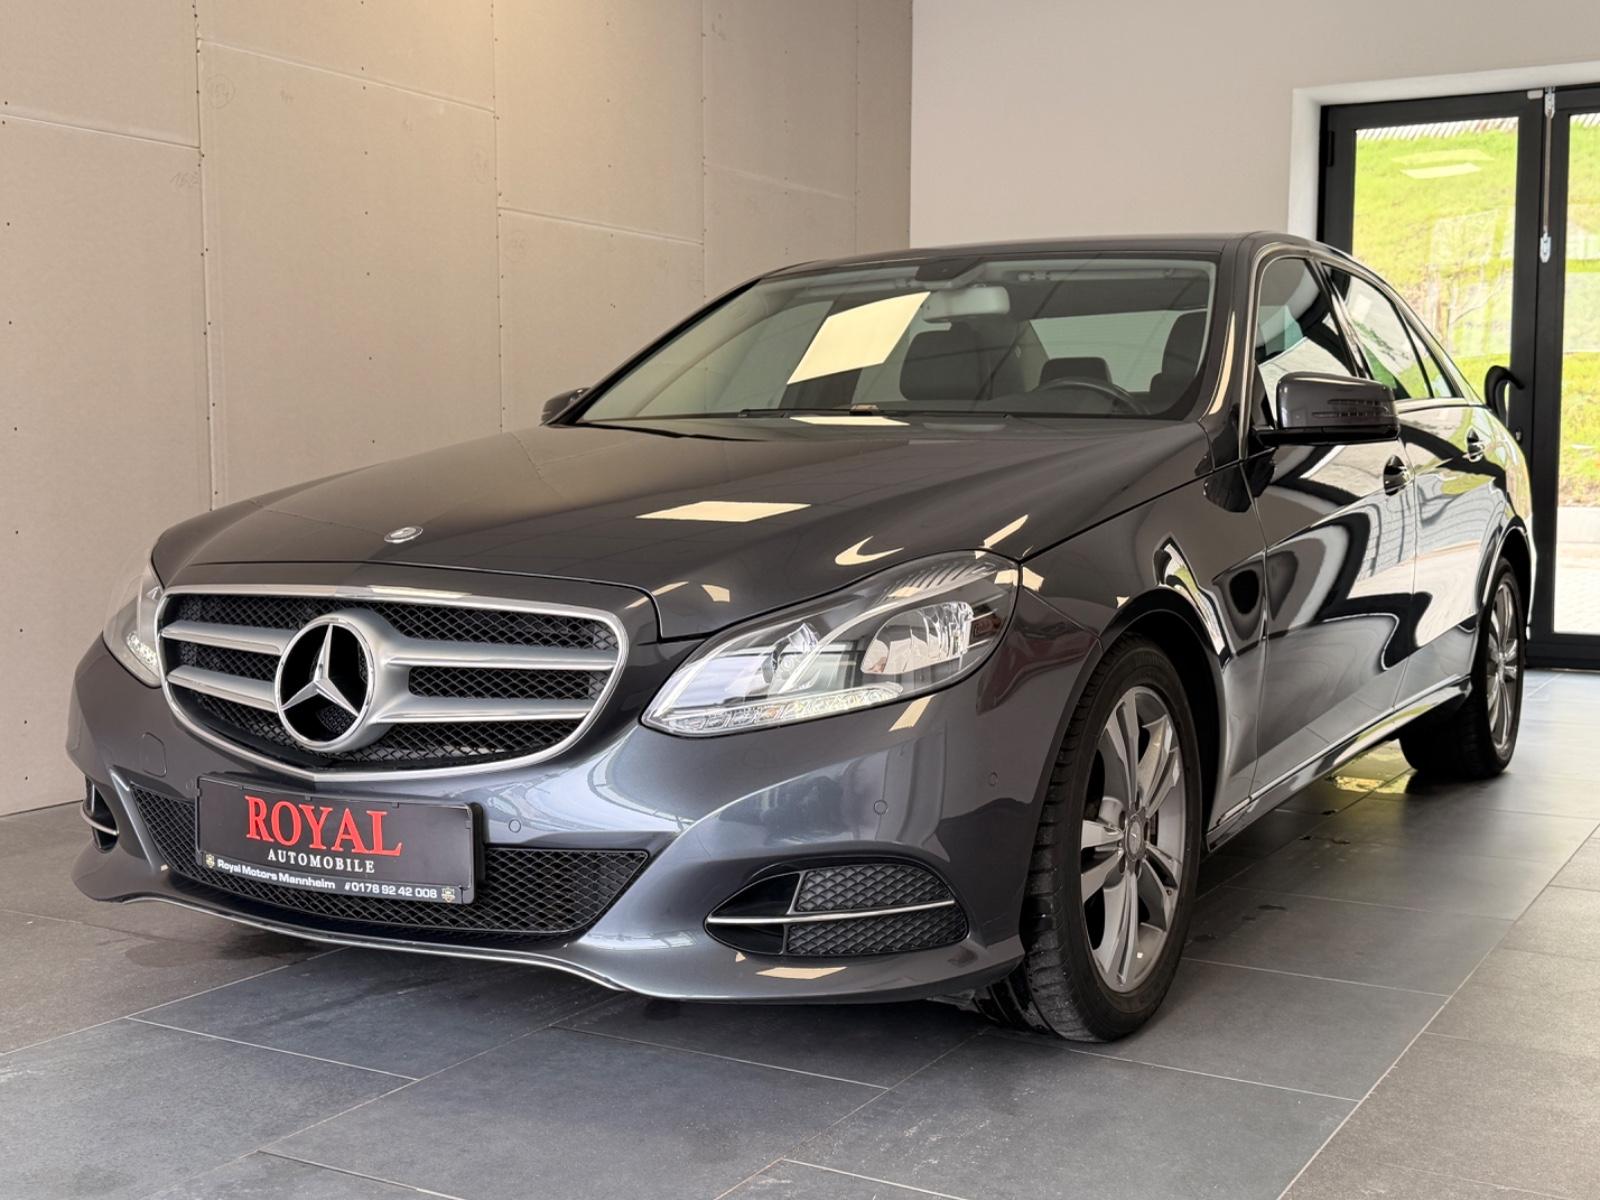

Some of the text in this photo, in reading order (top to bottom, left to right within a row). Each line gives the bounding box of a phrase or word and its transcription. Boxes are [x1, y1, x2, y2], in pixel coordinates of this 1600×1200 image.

[244, 795, 402, 857] ROYAL
[216, 858, 241, 874] Royal
[241, 865, 278, 881] Motors
[278, 872, 336, 890] Mannheim
[397, 886, 413, 897] 42
[267, 848, 375, 874] AUTOMOBILE
